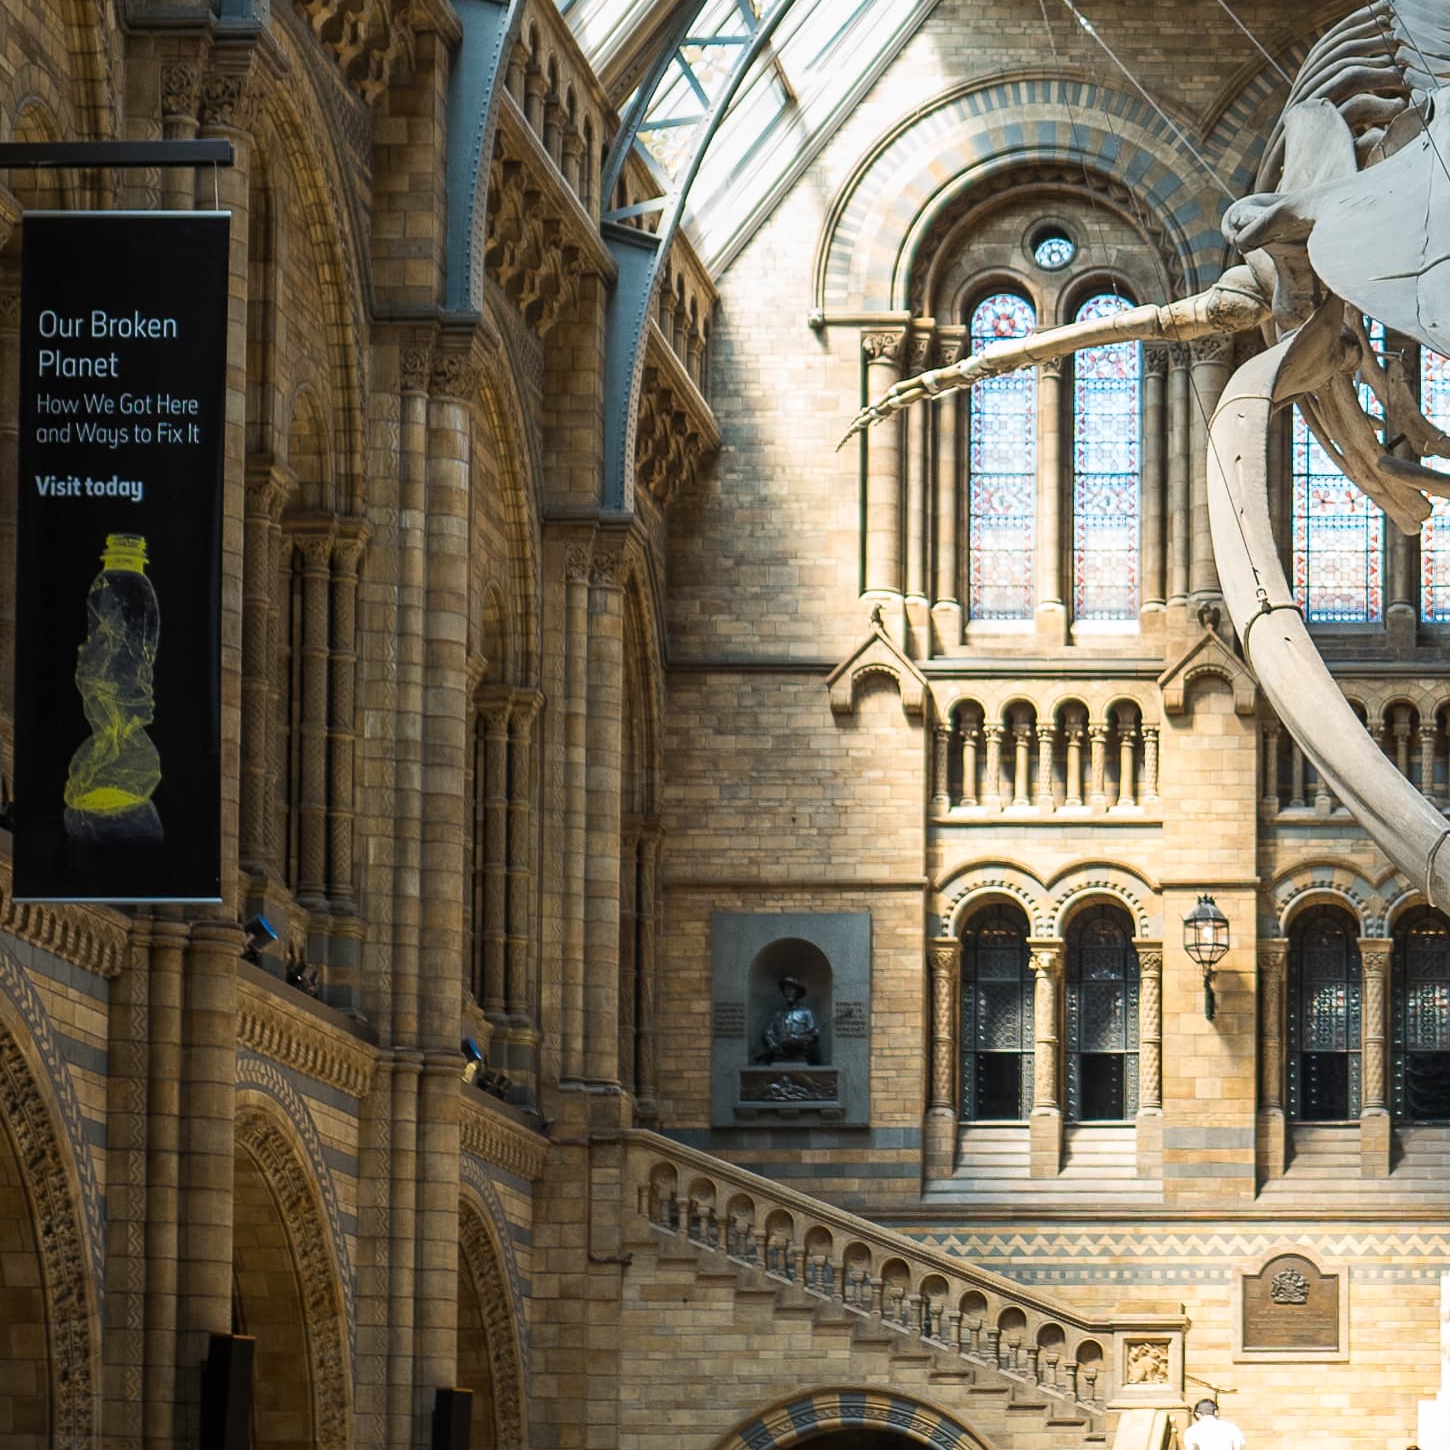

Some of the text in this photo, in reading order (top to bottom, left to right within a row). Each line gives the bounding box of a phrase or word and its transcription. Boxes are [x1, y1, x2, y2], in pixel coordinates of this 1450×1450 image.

[38, 309, 177, 338] Our Broken
[38, 349, 119, 377] Planet
[36, 392, 199, 415] How We Got Here
[36, 422, 200, 449] and Ways to Fix It
[35, 475, 144, 502] Visit today
